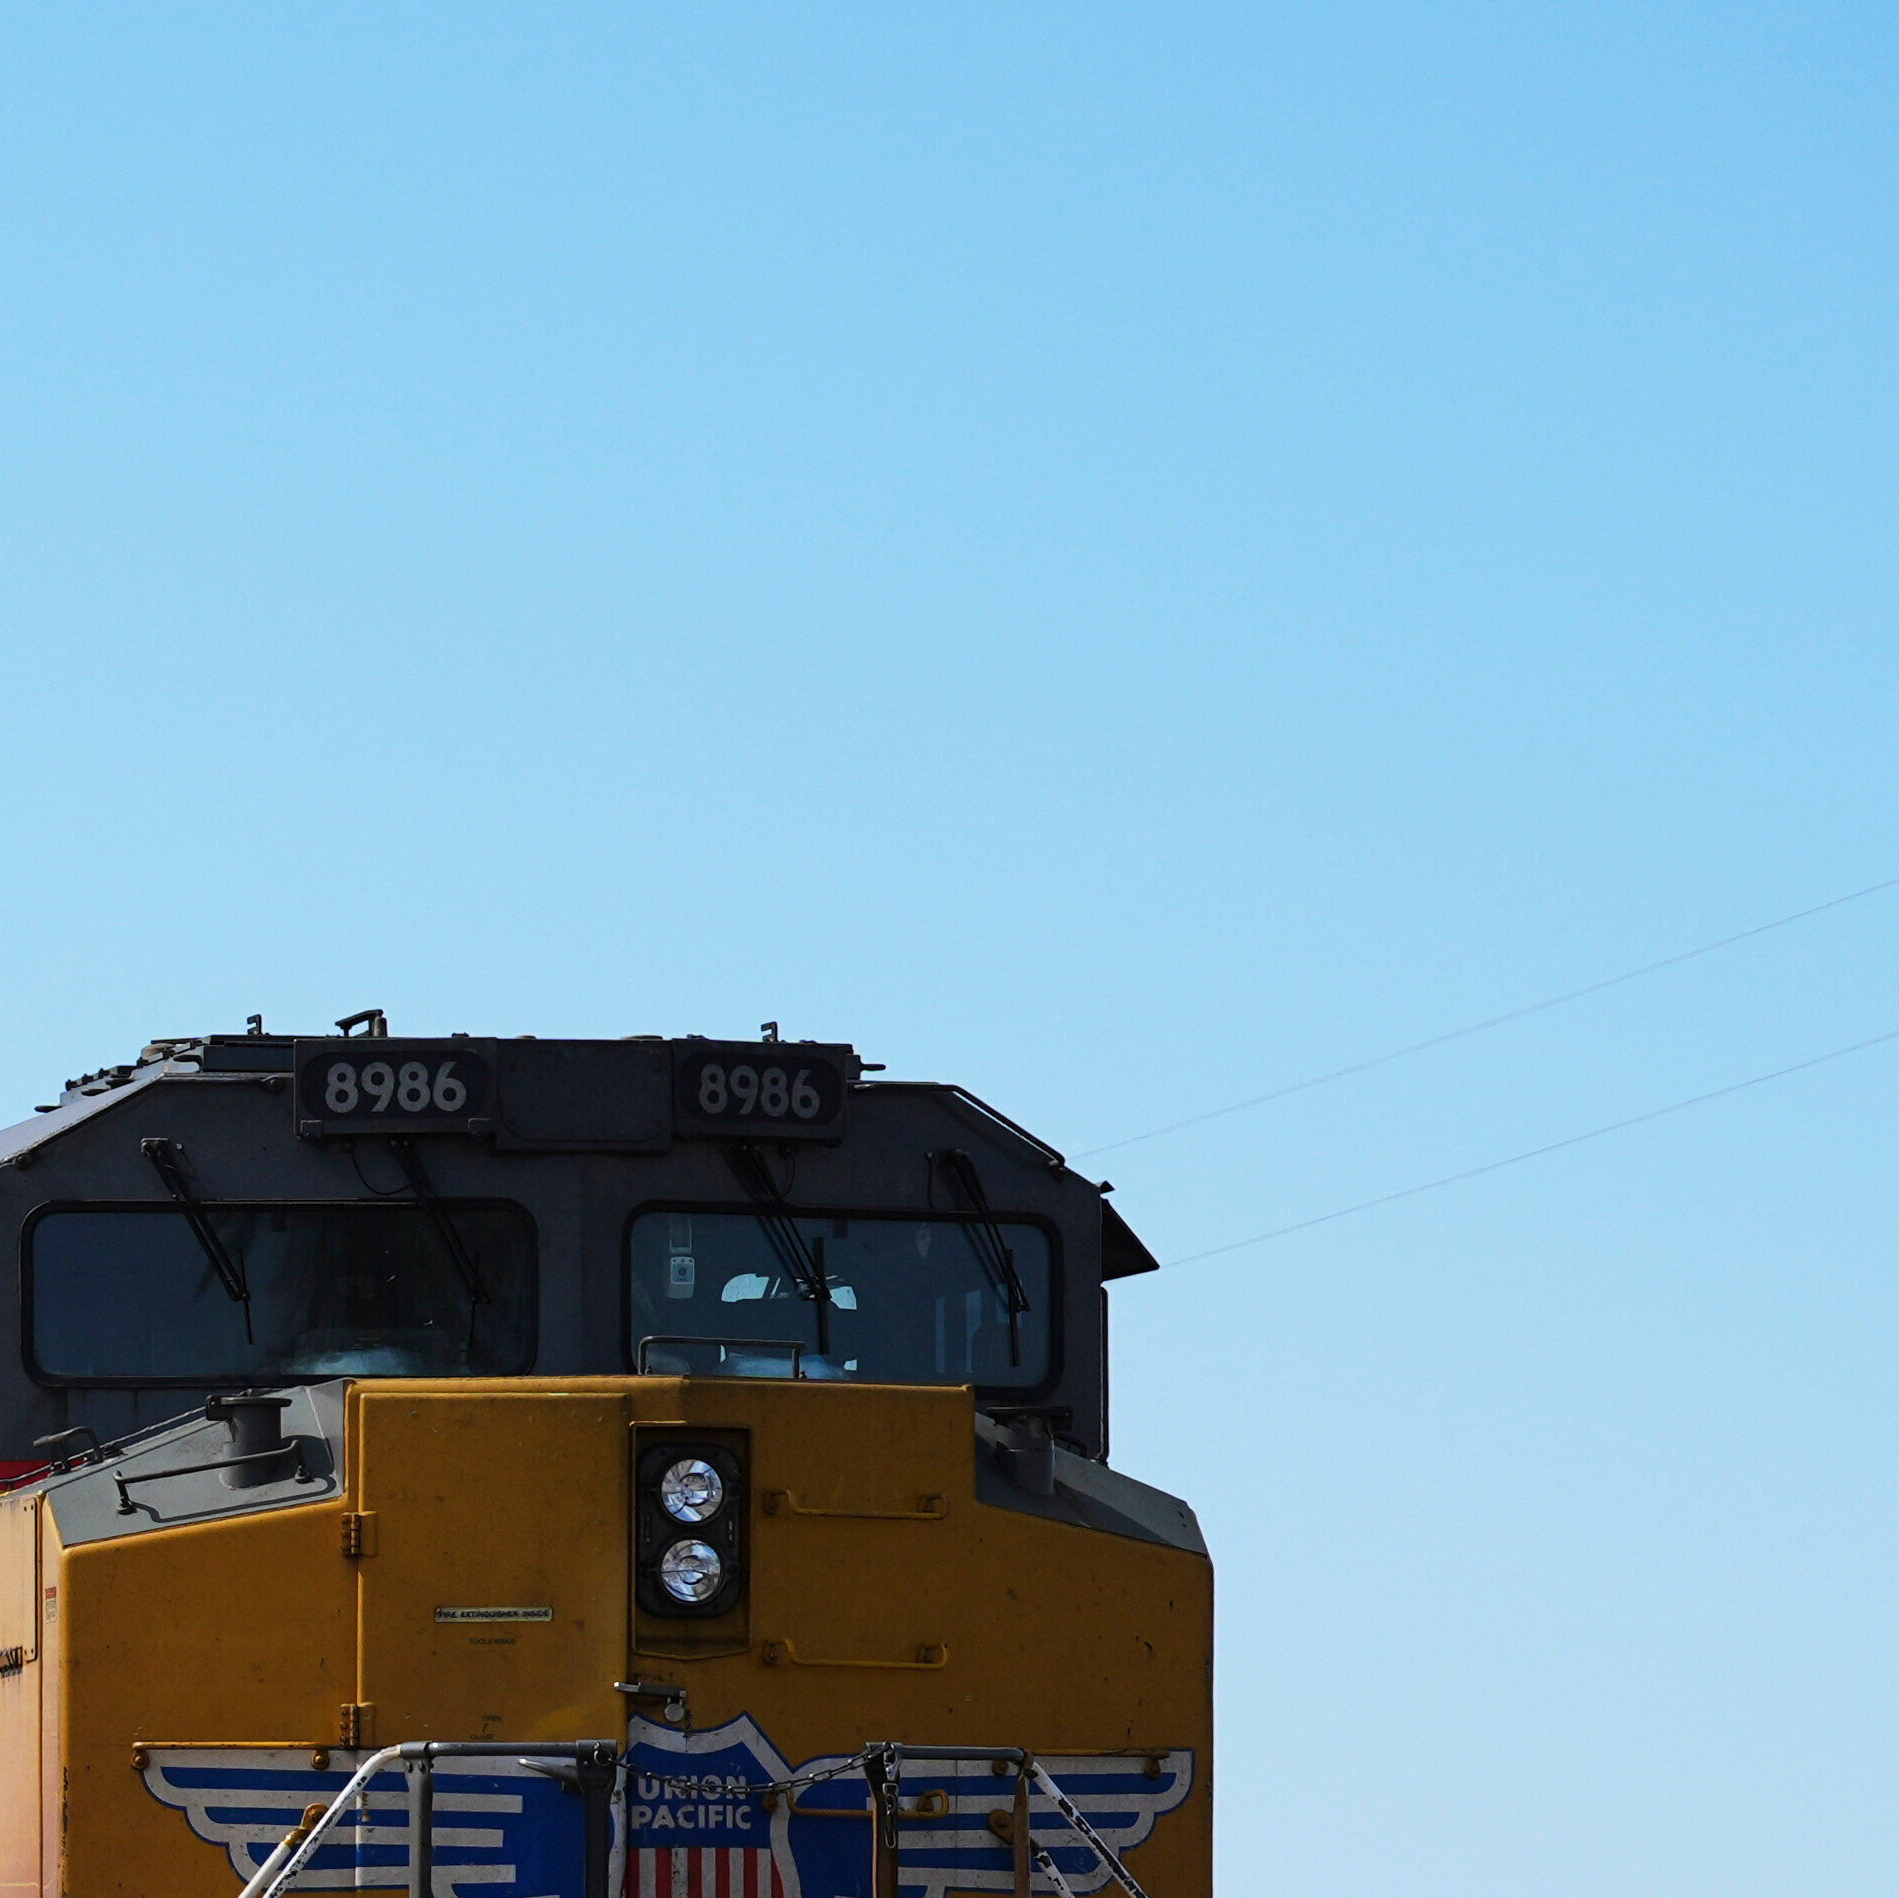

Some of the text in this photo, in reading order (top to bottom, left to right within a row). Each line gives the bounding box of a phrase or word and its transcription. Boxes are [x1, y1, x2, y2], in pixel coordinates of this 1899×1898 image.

[325, 1060, 468, 1114] 8986
[698, 1063, 822, 1119] 8986
[638, 1774, 747, 1800] UNION
[631, 1804, 752, 1830] PACIFIC
